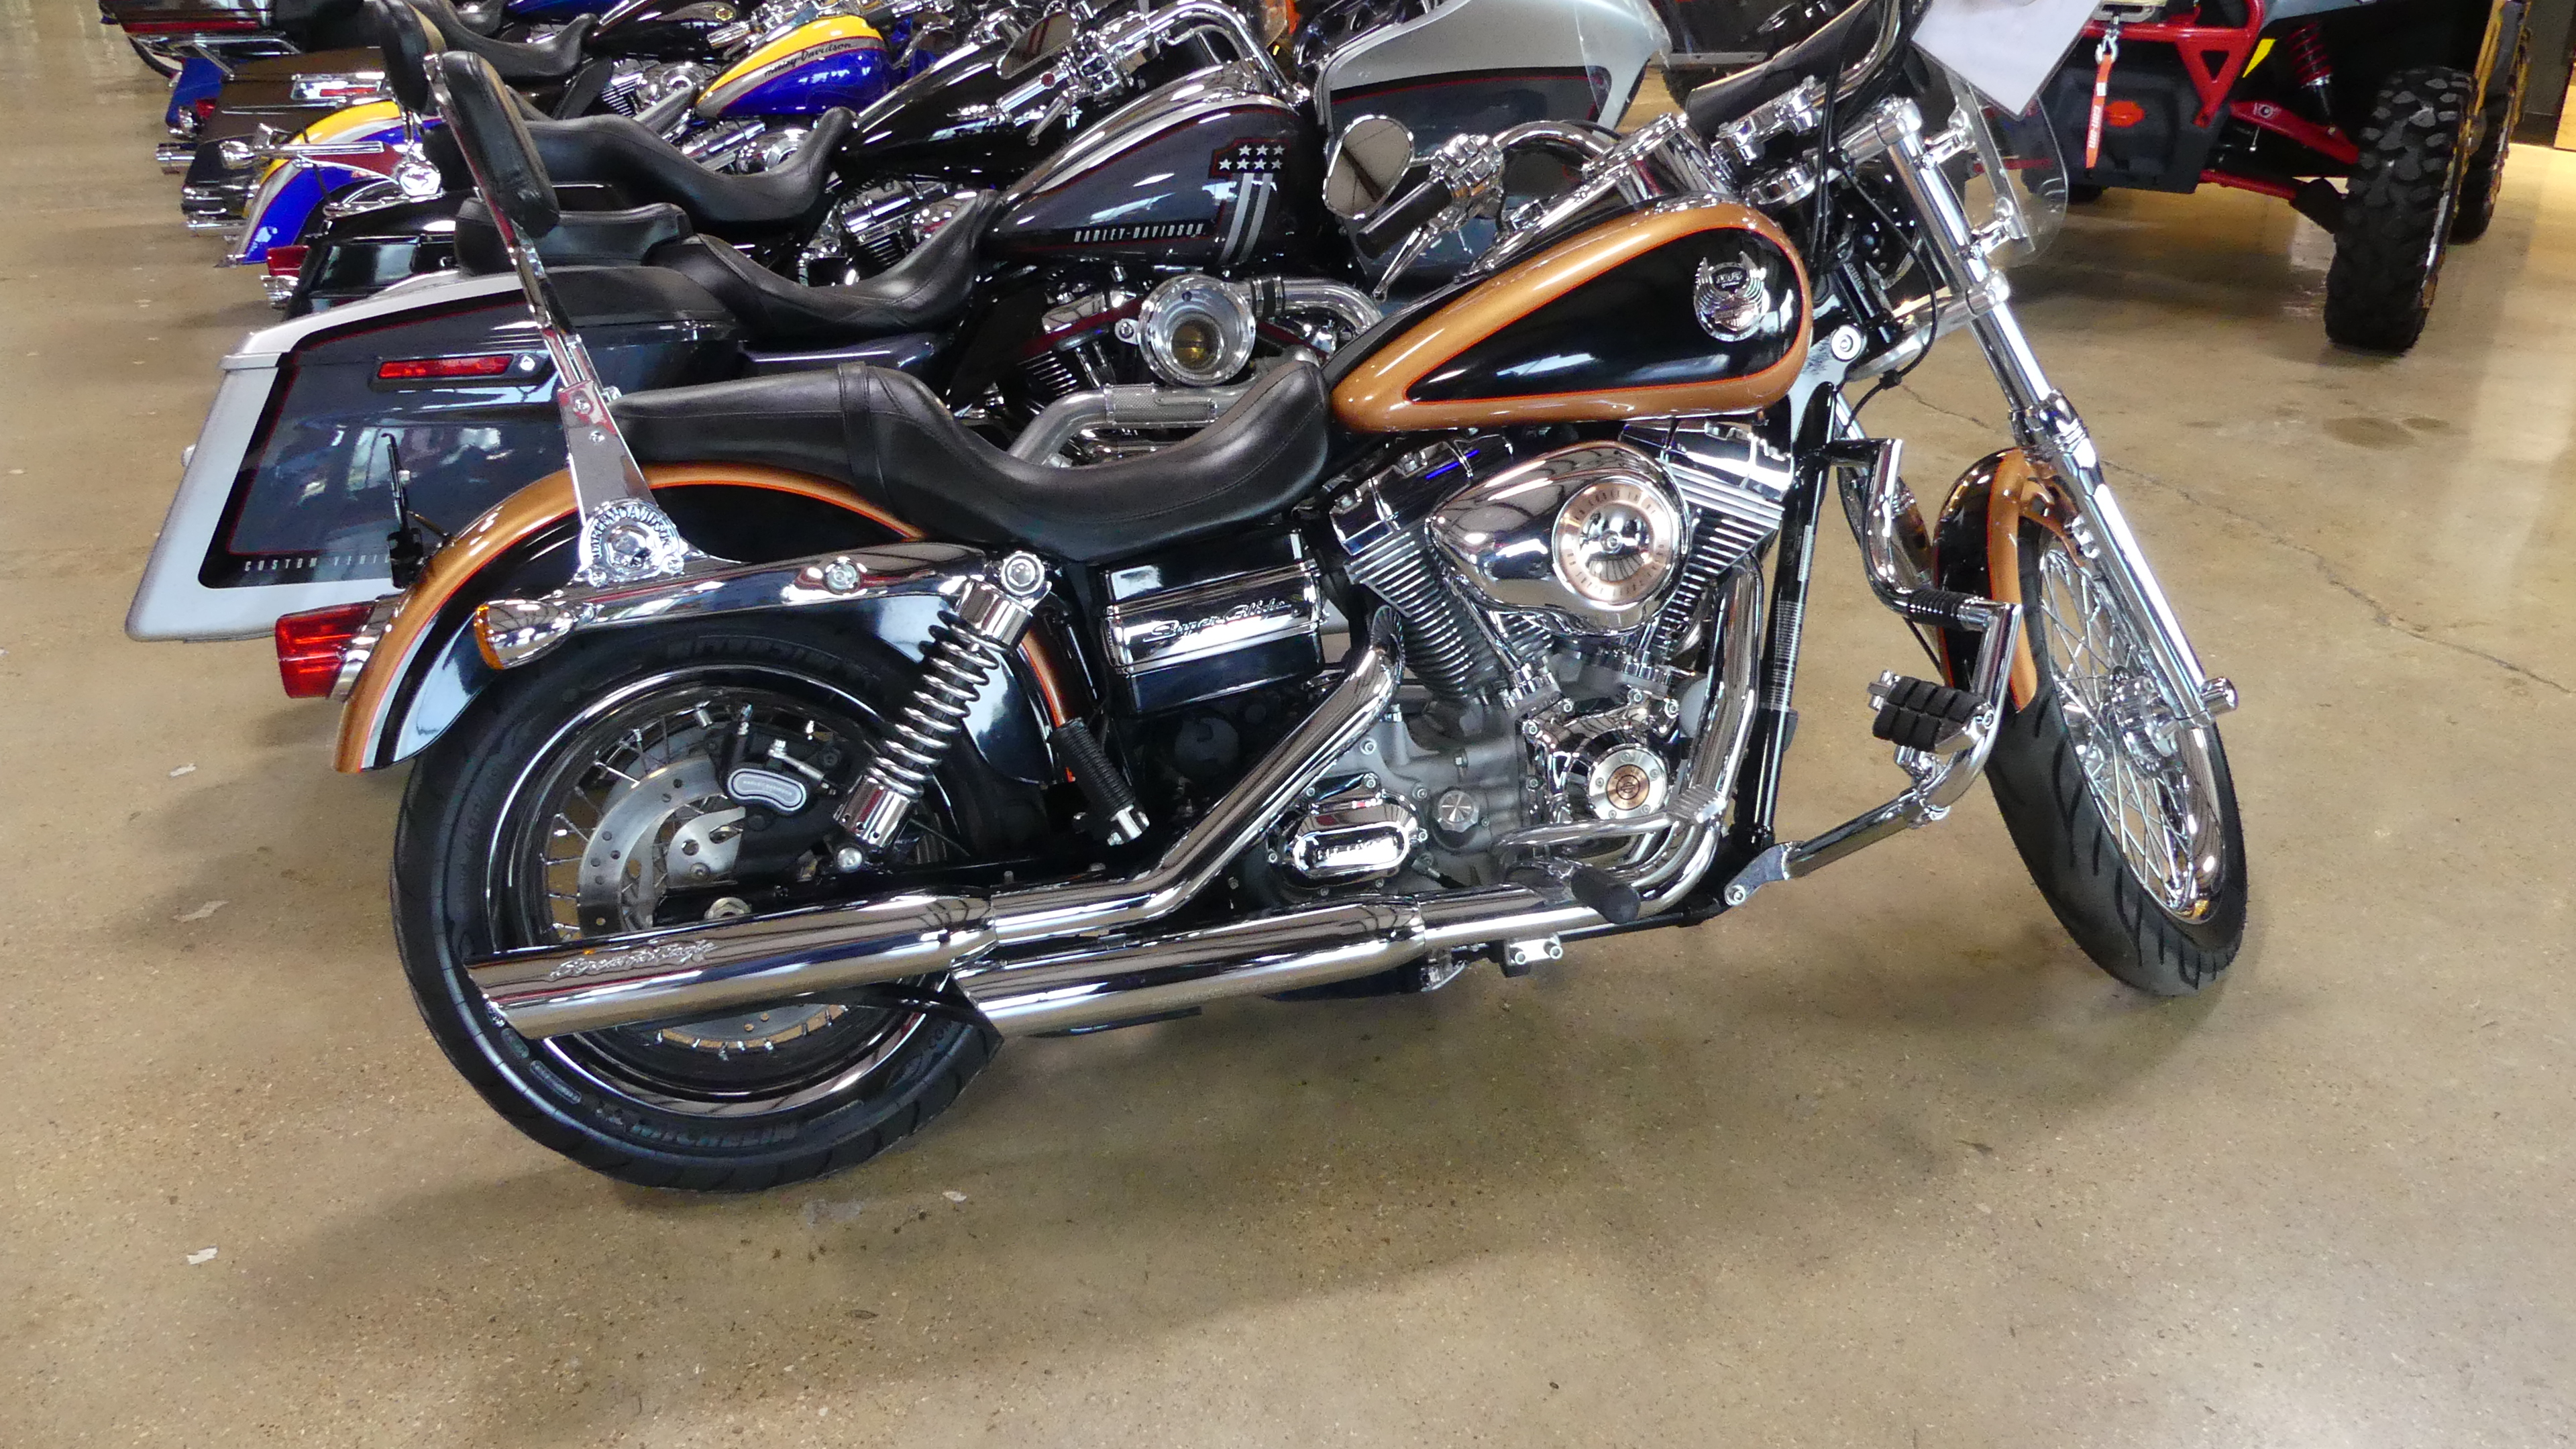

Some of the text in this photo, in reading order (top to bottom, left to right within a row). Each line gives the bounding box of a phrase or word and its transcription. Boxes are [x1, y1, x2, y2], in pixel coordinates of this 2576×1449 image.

[1073, 223, 1204, 243] HARLEY-DAVIDSON
[244, 554, 390, 572] CUSTOM VEHIC
